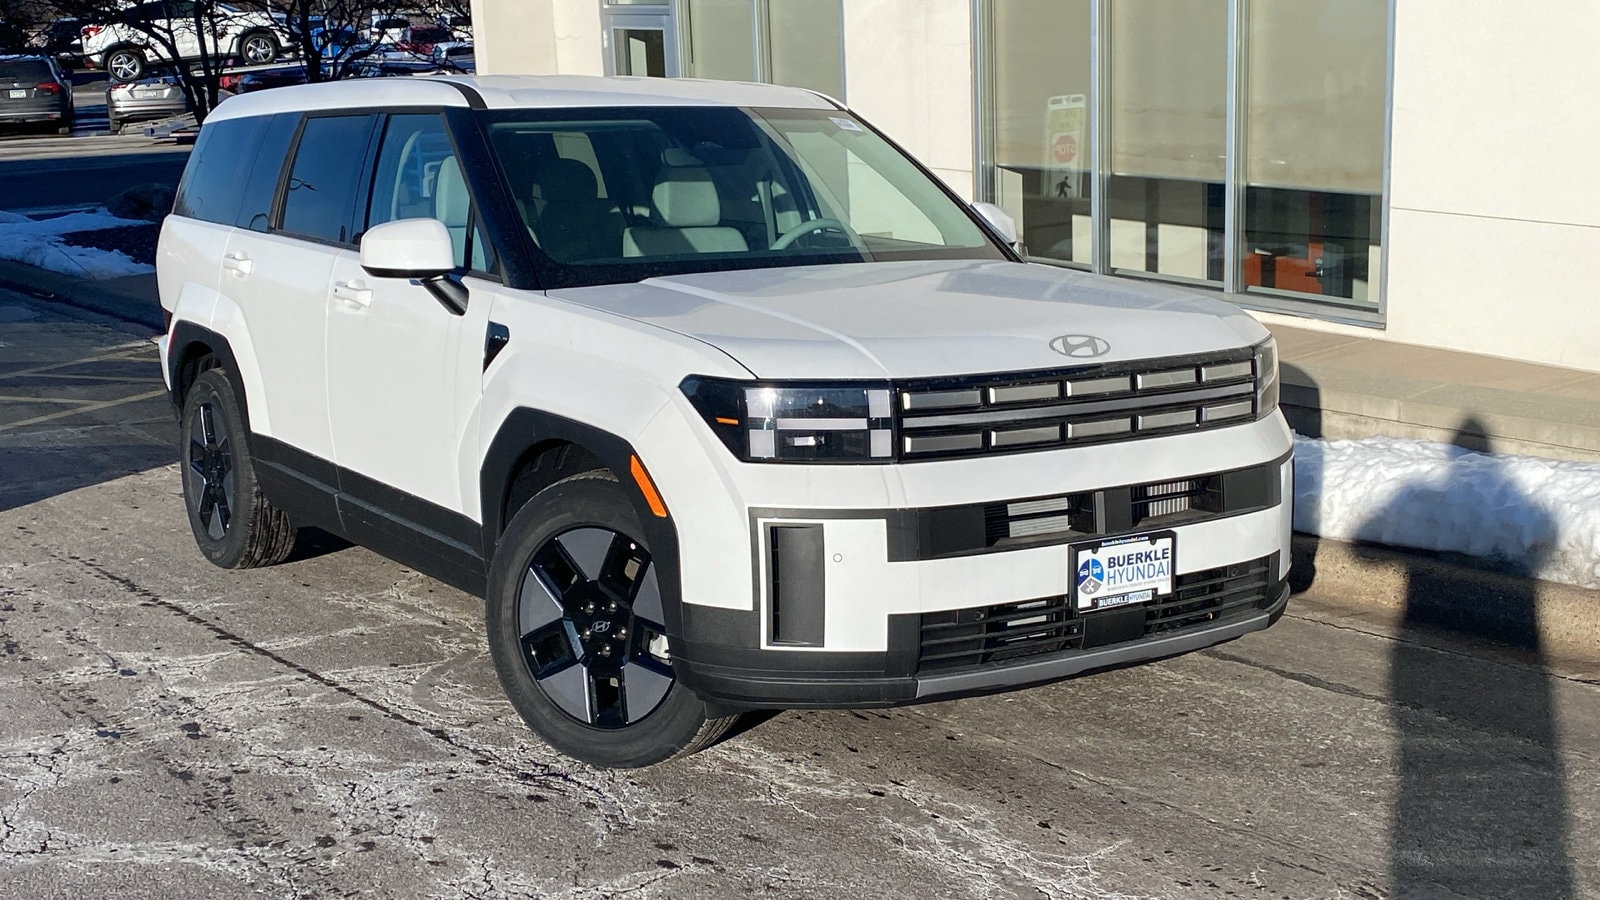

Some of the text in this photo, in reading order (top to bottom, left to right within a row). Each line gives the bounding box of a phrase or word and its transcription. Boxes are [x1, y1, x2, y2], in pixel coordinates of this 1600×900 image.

[1107, 547, 1169, 569] BUERKLE
[1107, 560, 1169, 585] HYUNDAI
[1099, 591, 1150, 606] BUERKLE HYUNDAI
